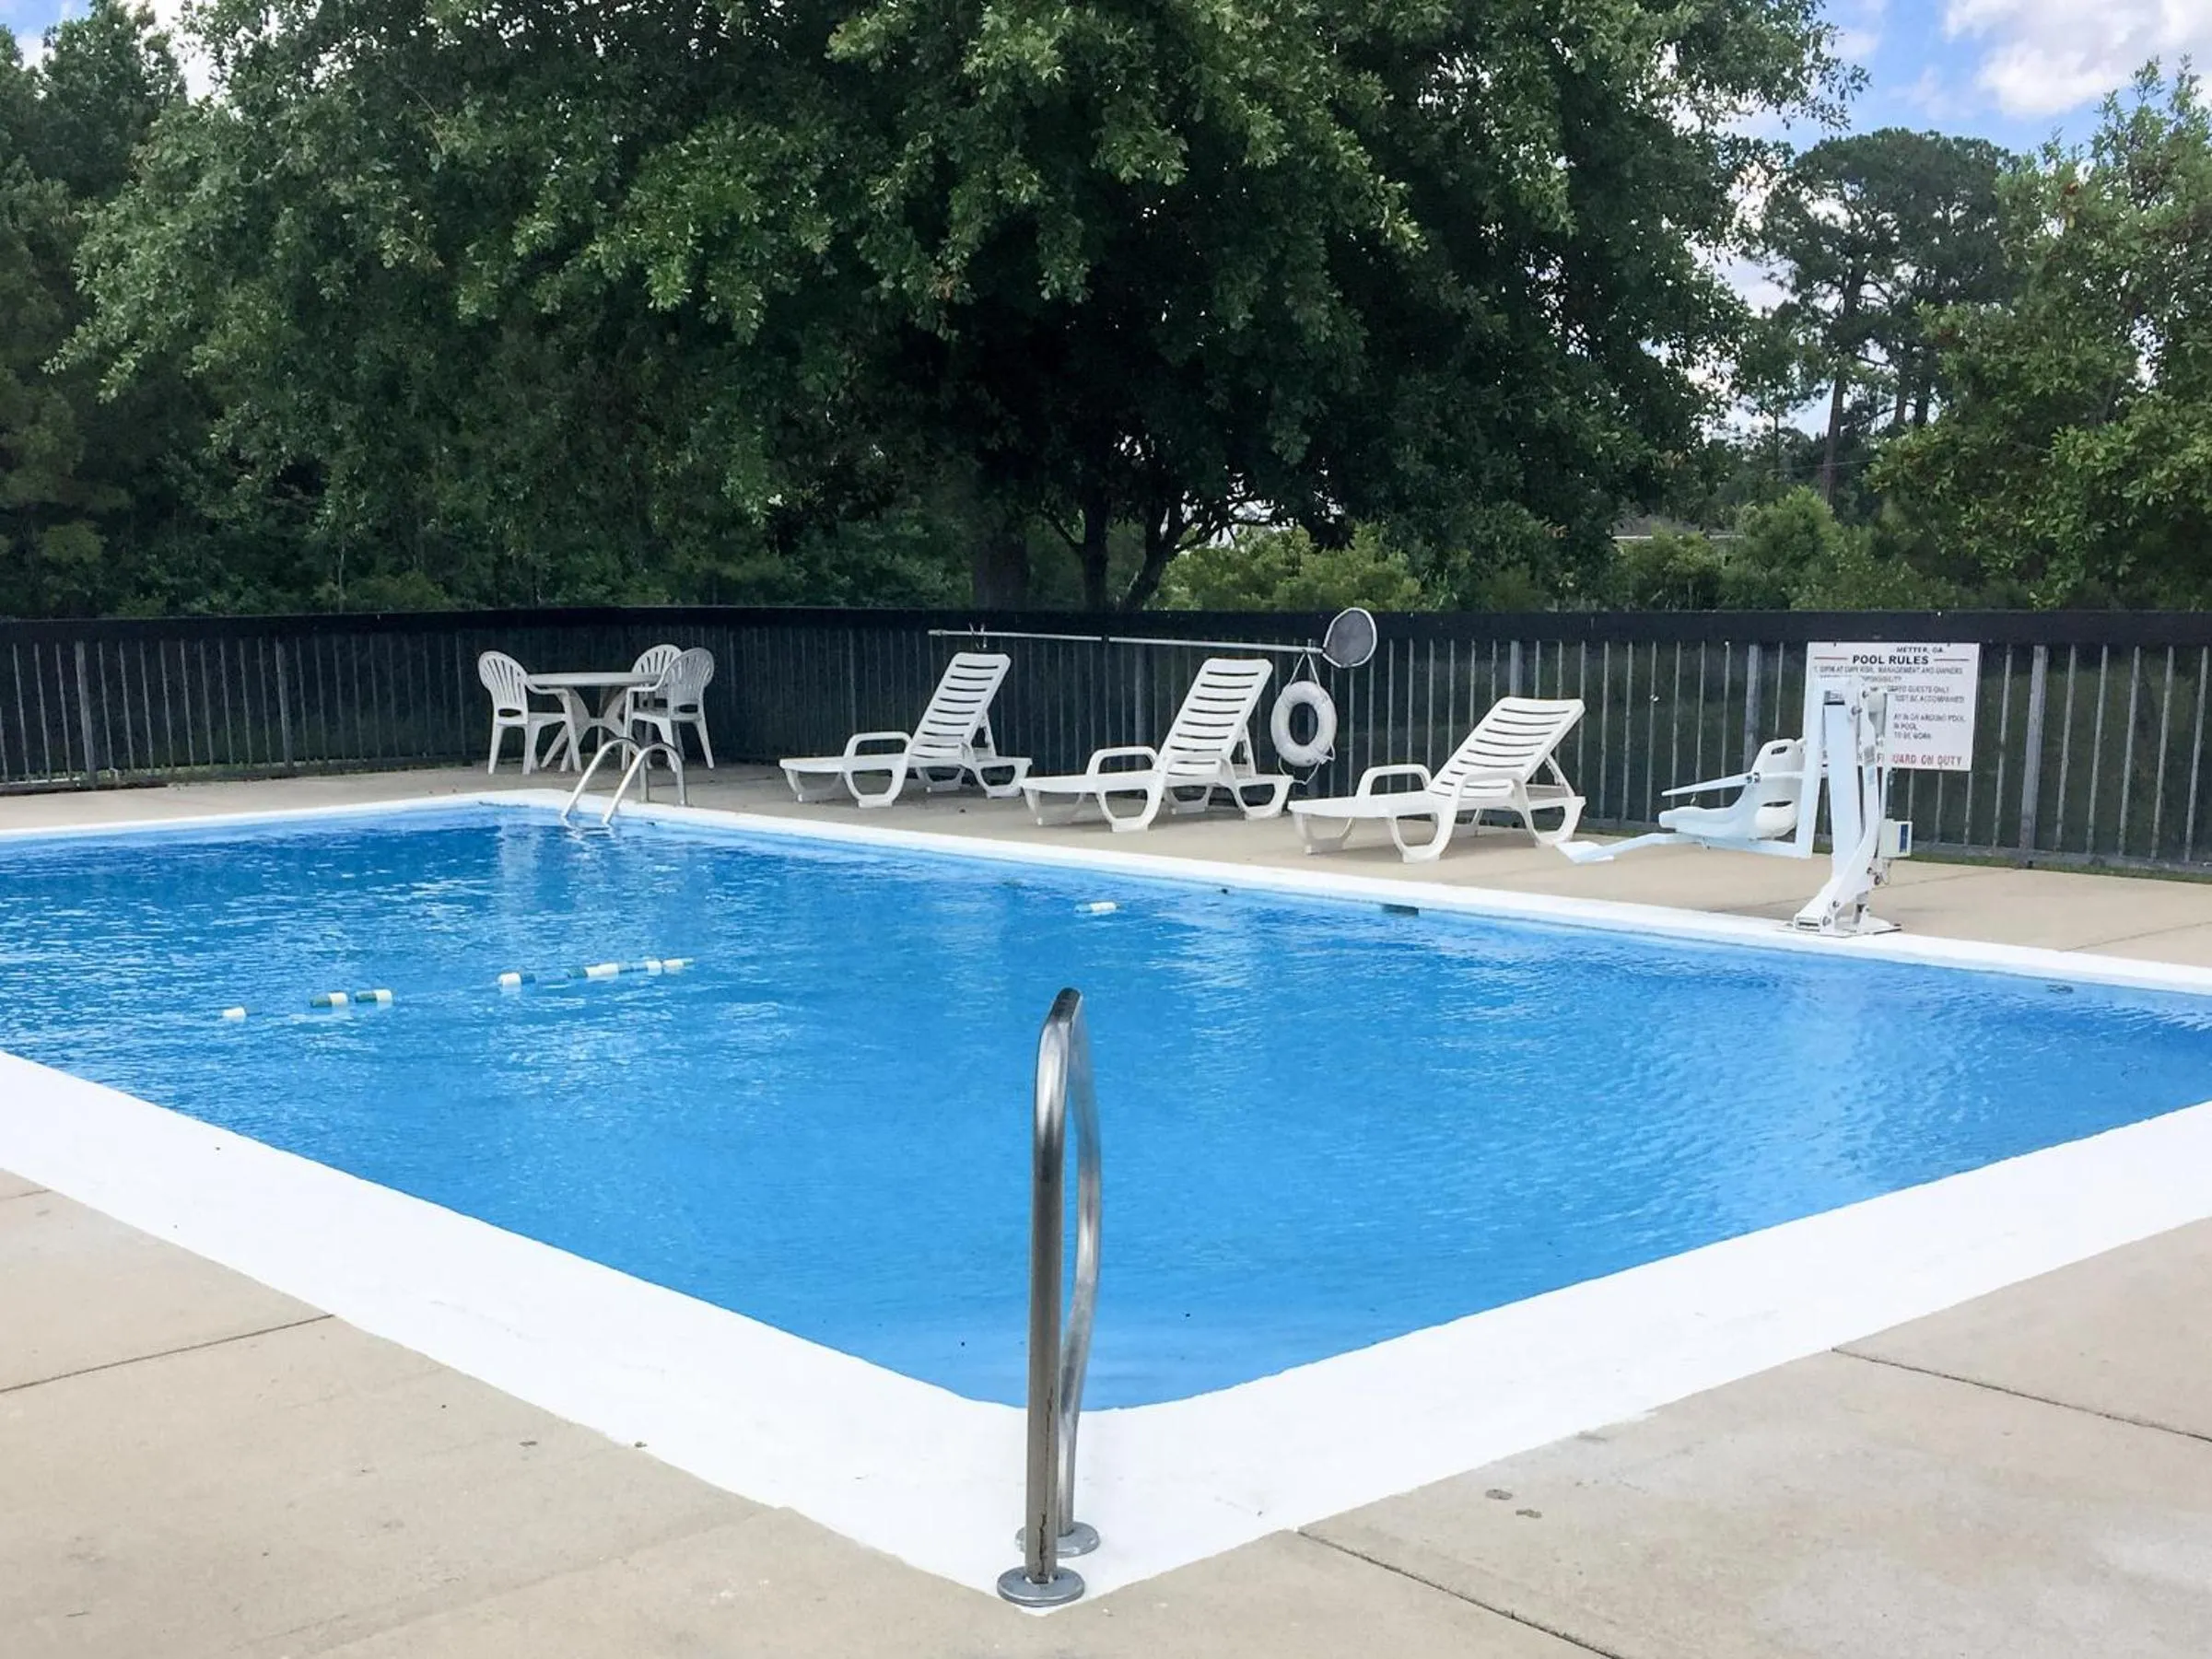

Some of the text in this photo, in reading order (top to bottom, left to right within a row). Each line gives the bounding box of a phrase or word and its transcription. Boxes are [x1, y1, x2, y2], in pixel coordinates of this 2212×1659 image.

[1852, 655, 1929, 665] POOL RULES
[1921, 754, 1934, 765] ON
[1937, 754, 1962, 766] DUTY
